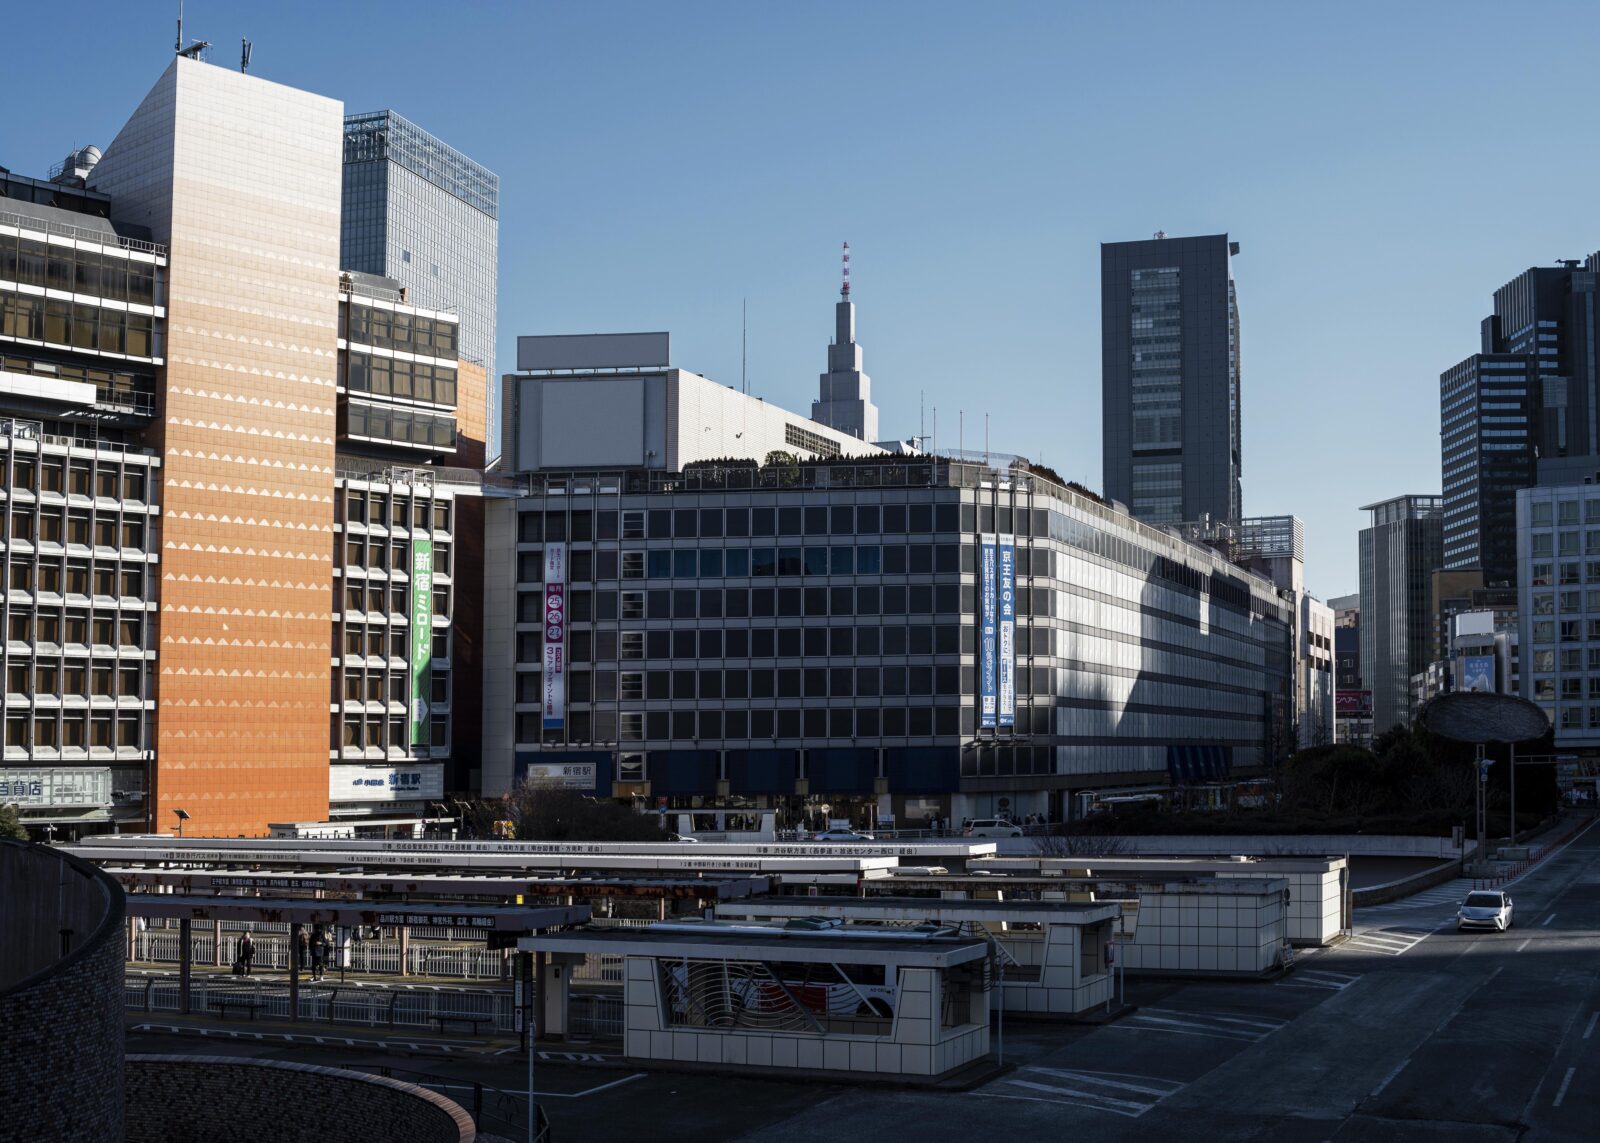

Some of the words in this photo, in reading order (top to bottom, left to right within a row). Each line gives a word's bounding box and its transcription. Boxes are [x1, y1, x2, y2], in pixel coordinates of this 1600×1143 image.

[1002, 551, 1011, 615] 京王友の会
[415, 552, 430, 660] 新宿ミロード
[388, 773, 421, 785] 新宿駅
[563, 766, 592, 776] 新宿駅
[0, 780, 43, 796] 百貨店
